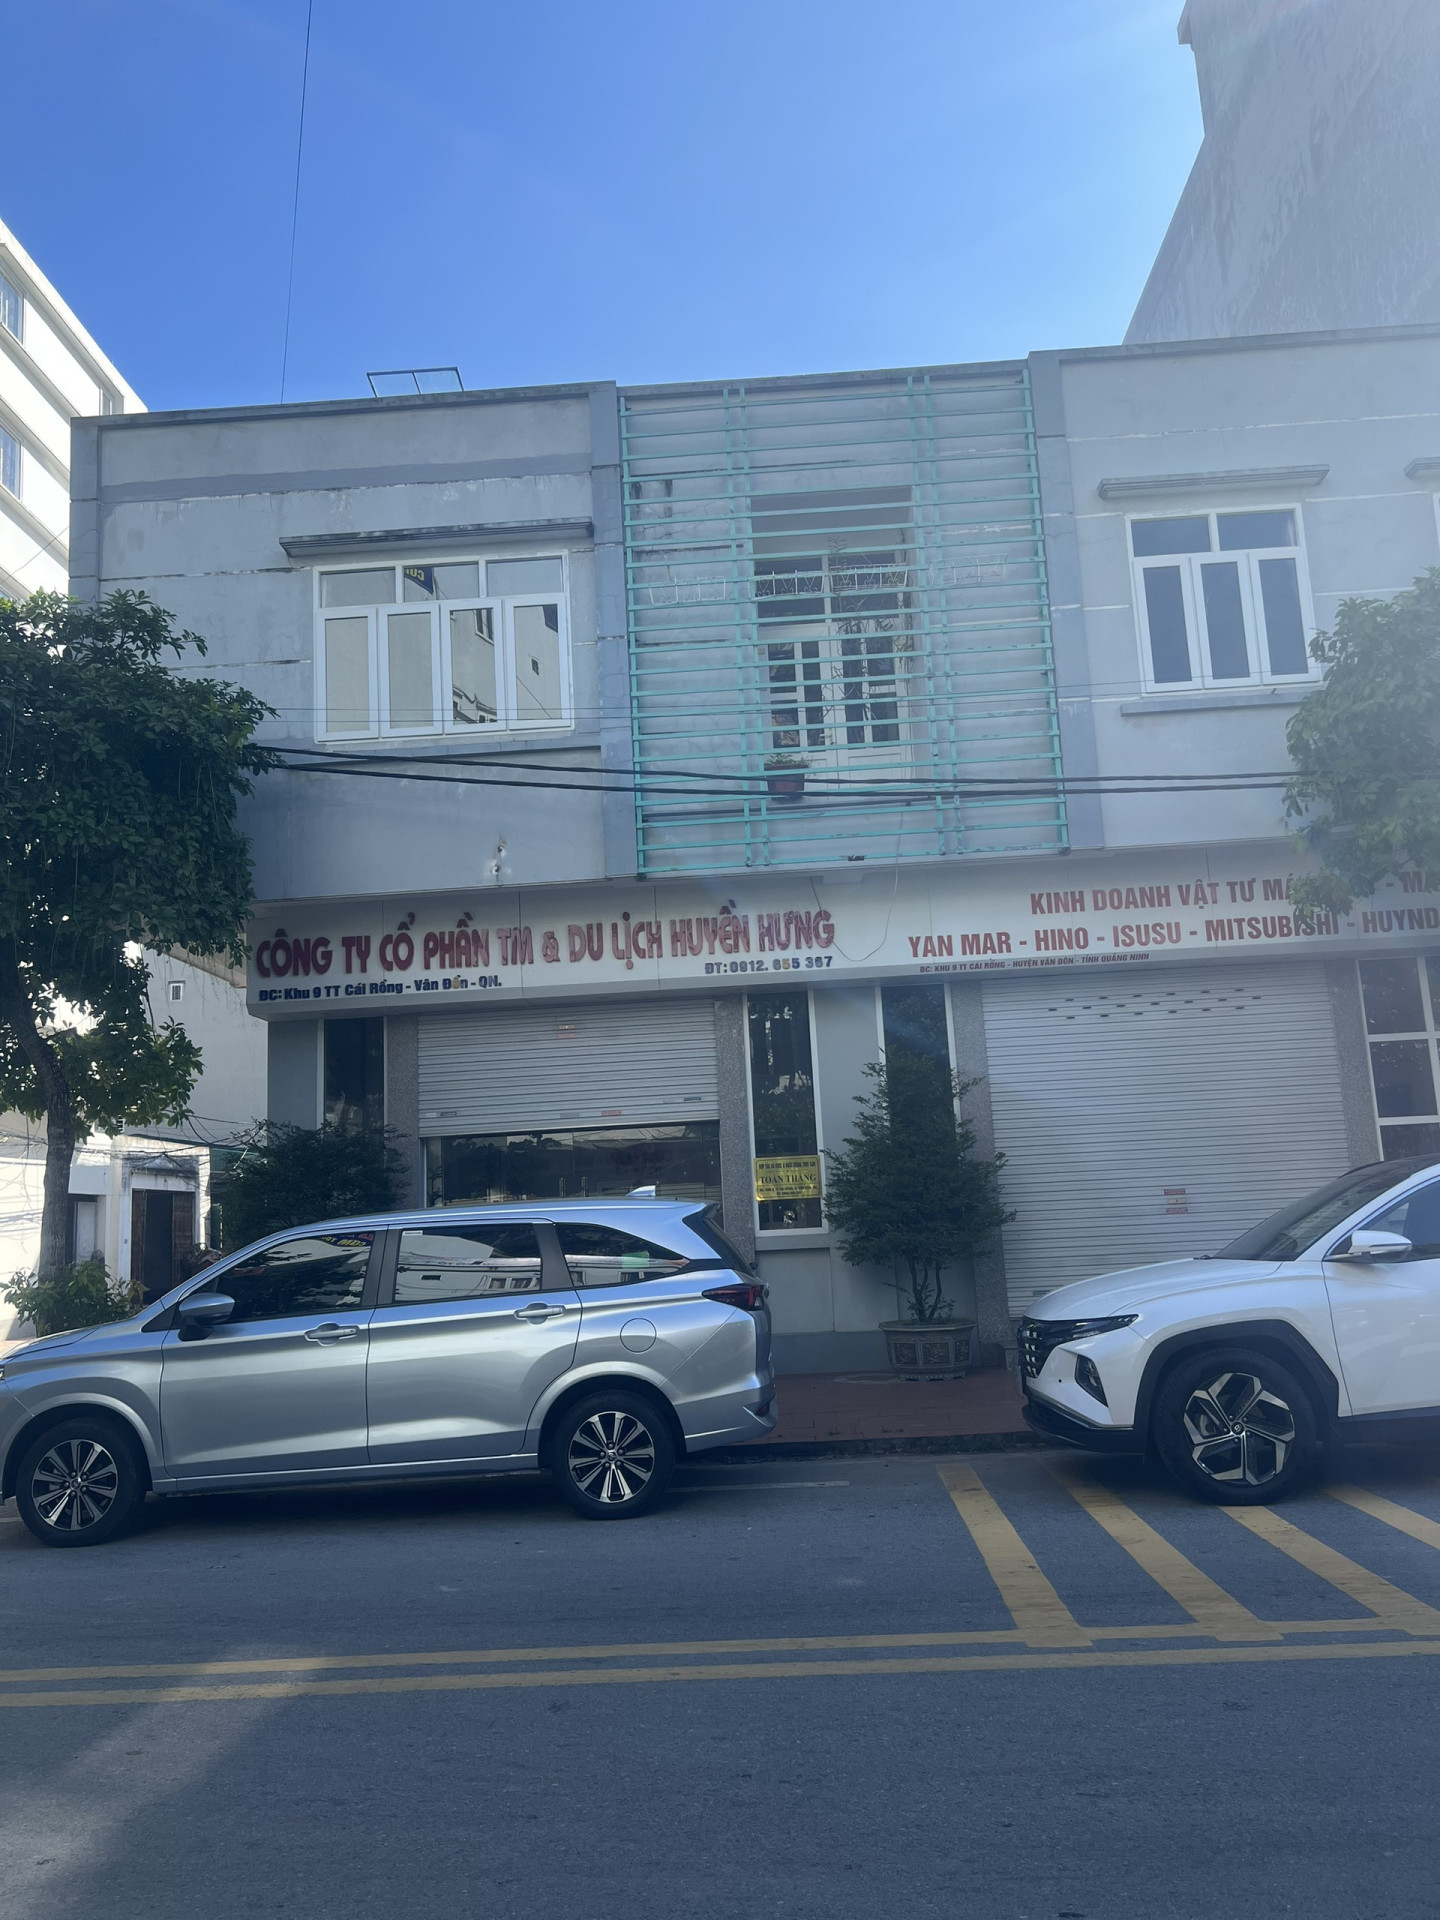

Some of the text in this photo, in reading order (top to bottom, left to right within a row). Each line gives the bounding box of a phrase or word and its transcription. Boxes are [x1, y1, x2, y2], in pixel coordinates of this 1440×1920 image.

[1030, 890, 1085, 915] KINH
[1092, 885, 1171, 912] DOANH
[1177, 879, 1219, 909] VẬT
[1226, 878, 1256, 903] TƯ
[256, 899, 835, 978] CÔNG TY CỔ PHẦN TM & DU LỊCH HUYỀN HƯNG
[908, 934, 954, 958] YAN
[960, 931, 1012, 956] MAR
[1034, 927, 1089, 952] HINO
[1112, 922, 1182, 948] ISUSU
[934, 964, 951, 972] KHU
[259, 989, 282, 1001] ĐC:
[284, 987, 310, 999] Khu
[313, 986, 322, 998] 9
[324, 985, 341, 998] TT
[345, 982, 367, 996] Cái
[369, 979, 404, 994] Rồng
[414, 978, 439, 991] Vân
